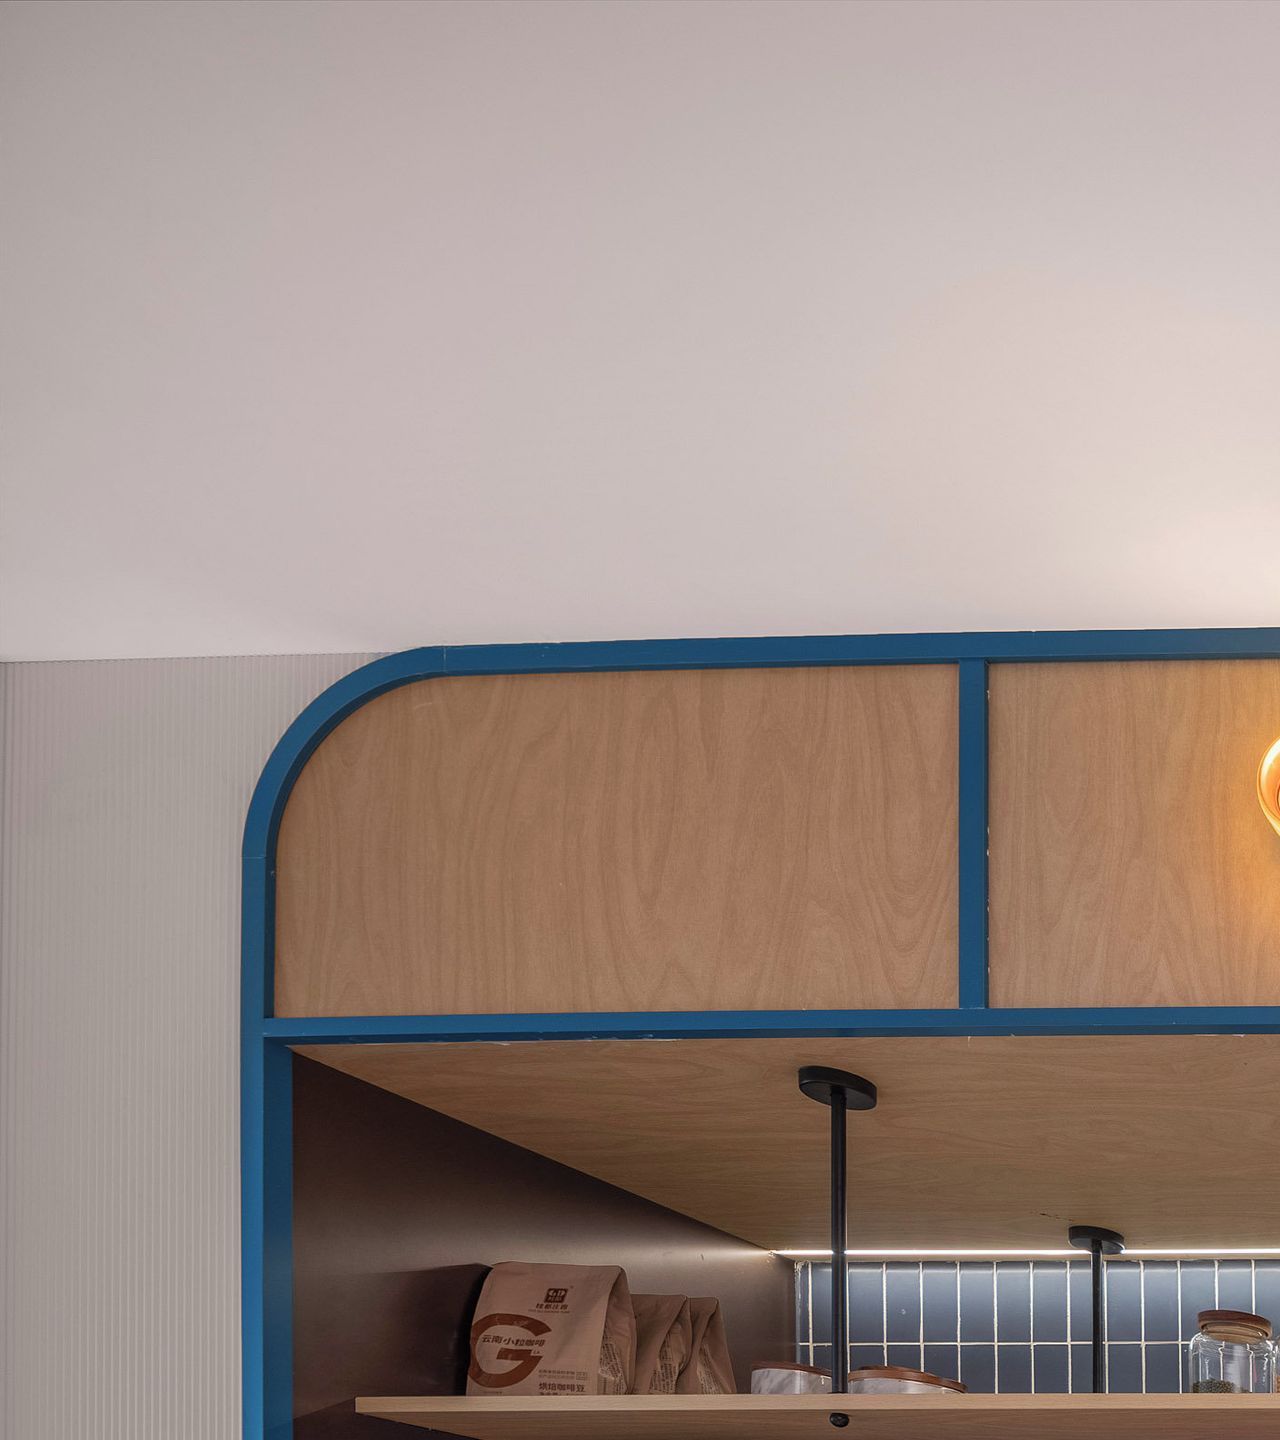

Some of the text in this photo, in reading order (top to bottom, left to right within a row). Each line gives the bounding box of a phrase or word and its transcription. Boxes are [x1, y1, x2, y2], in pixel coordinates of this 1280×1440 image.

[481, 1334, 546, 1347] 云南小粒咖啡
